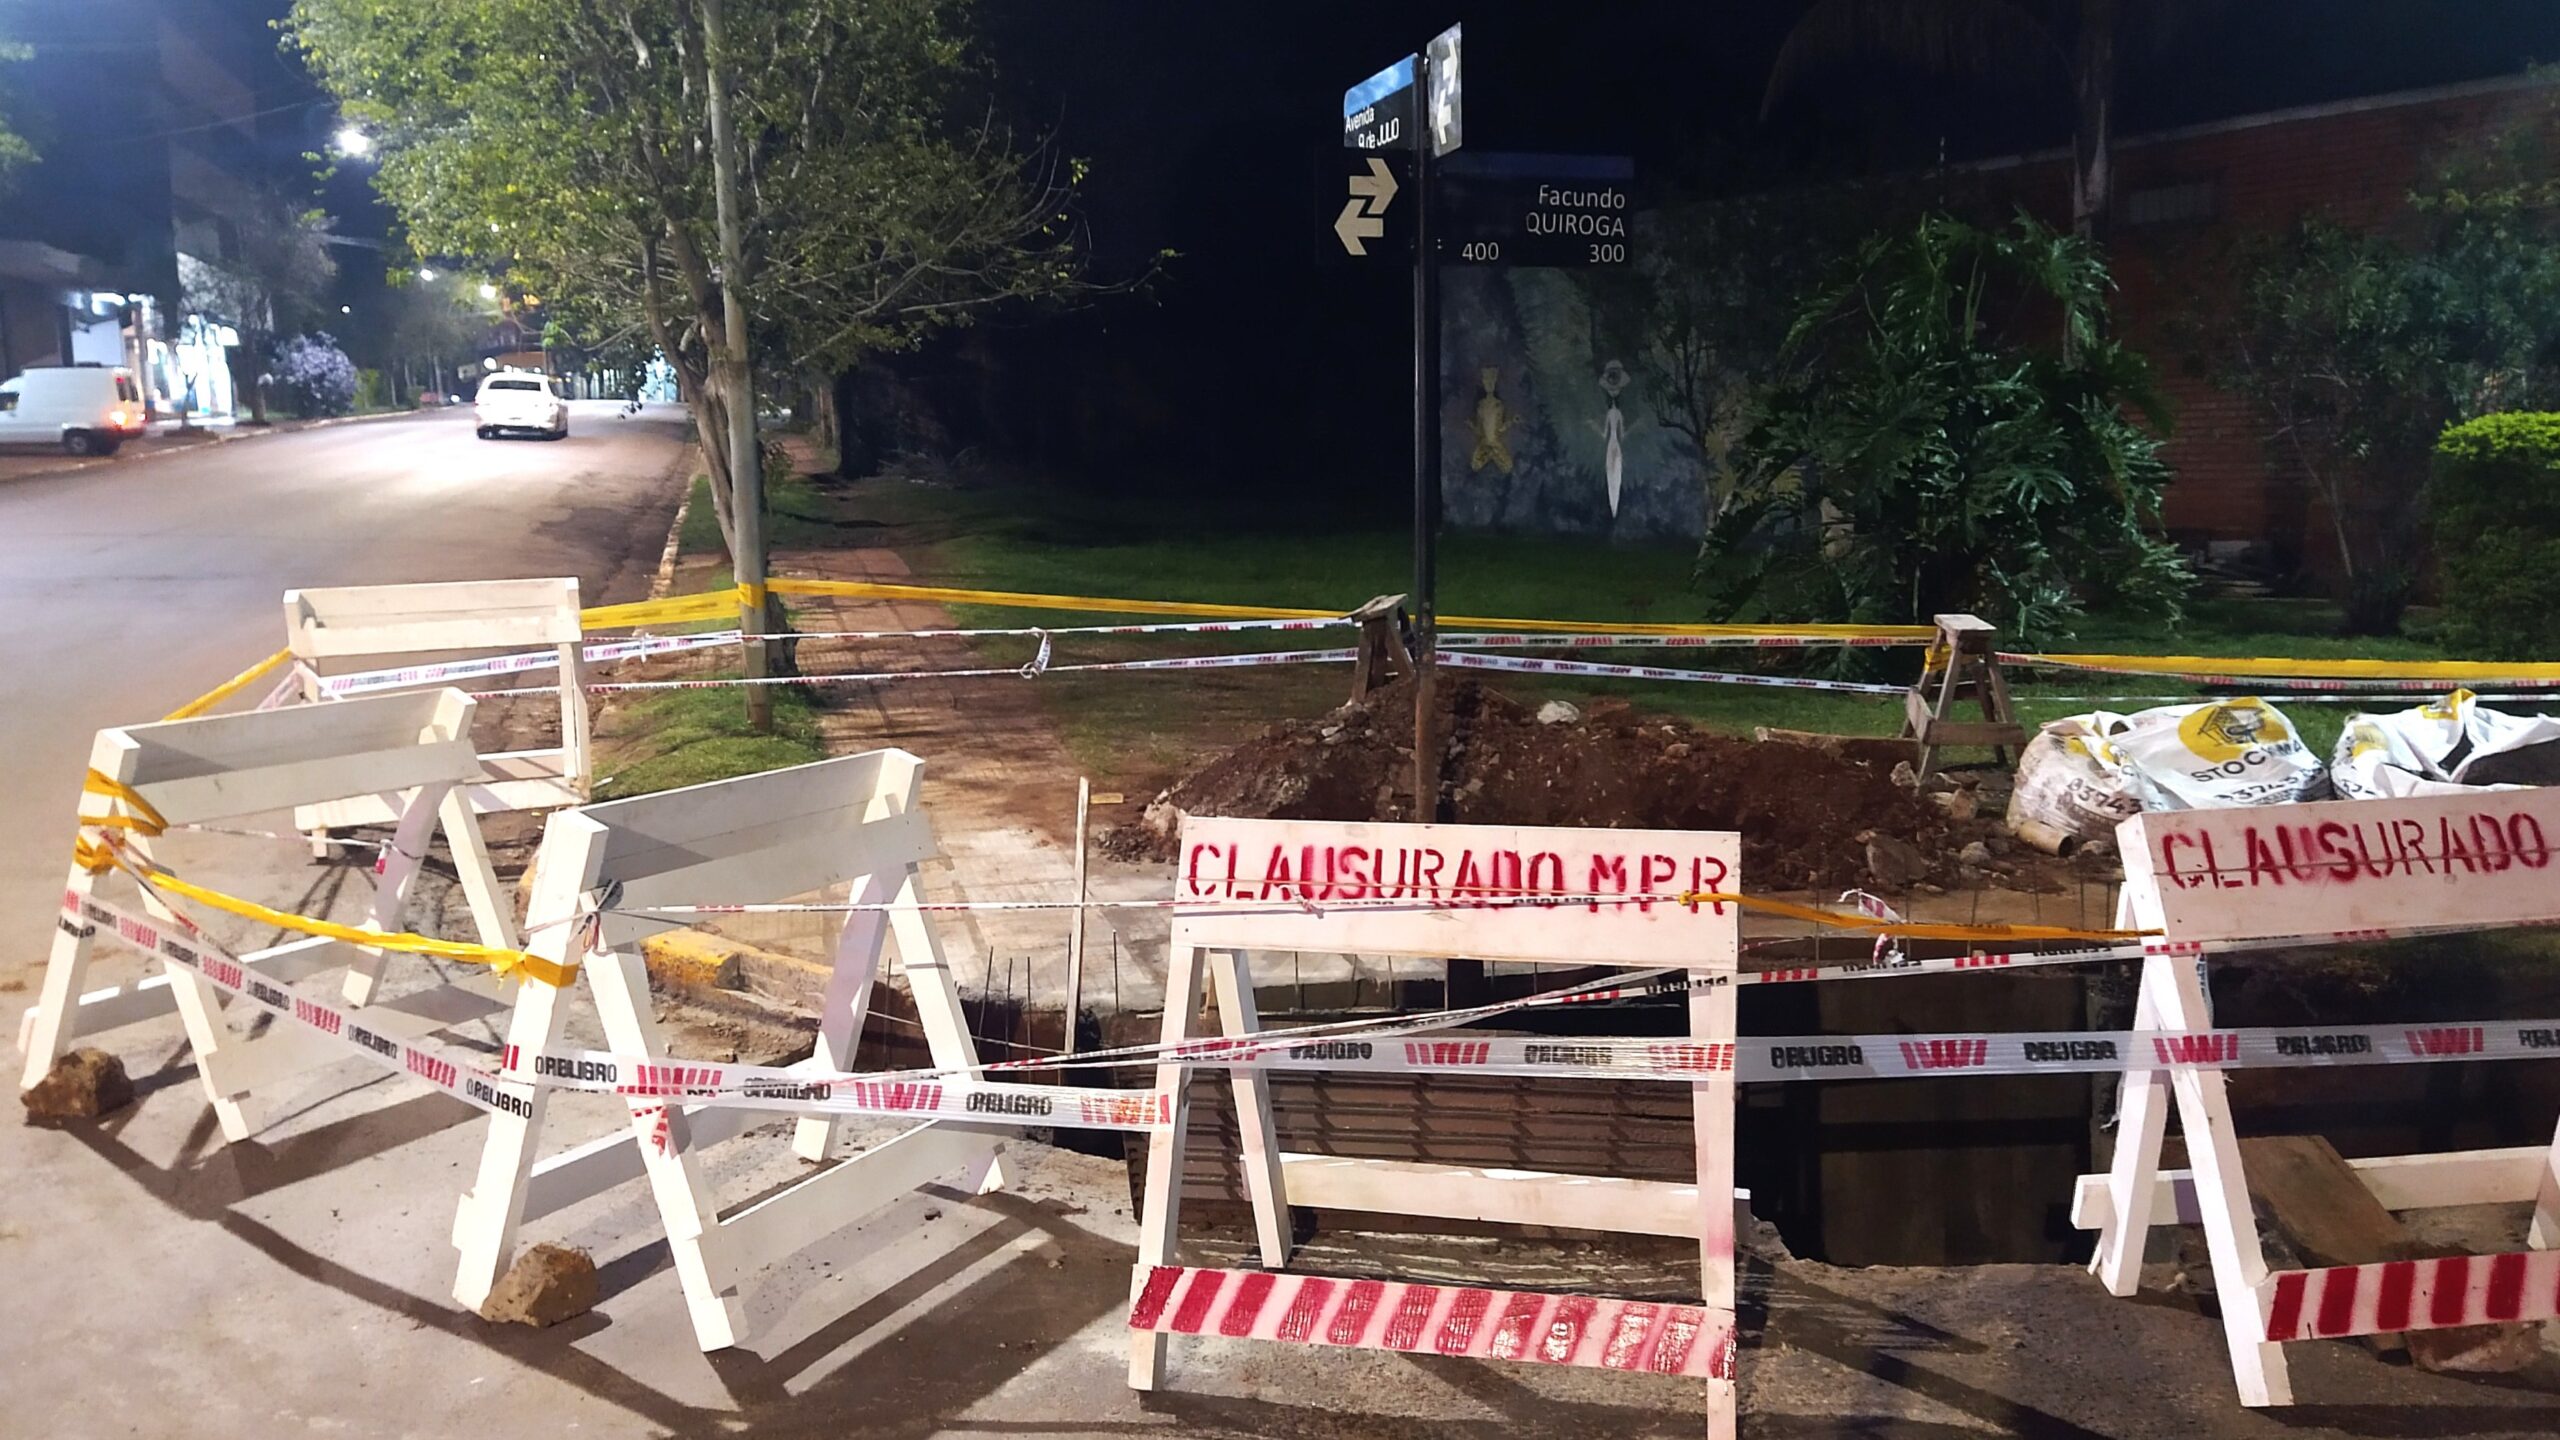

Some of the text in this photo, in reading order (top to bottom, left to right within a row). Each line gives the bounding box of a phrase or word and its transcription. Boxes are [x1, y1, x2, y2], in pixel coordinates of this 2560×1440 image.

[1345, 105, 1375, 135] Avenida
[1538, 184, 1626, 210] Facundo
[1525, 211, 1626, 238] QUIROGA
[1461, 242, 1626, 264] 400 300
[2162, 813, 2550, 890] CLAUSURADO
[1189, 844, 1564, 911] CLAUSURADO
